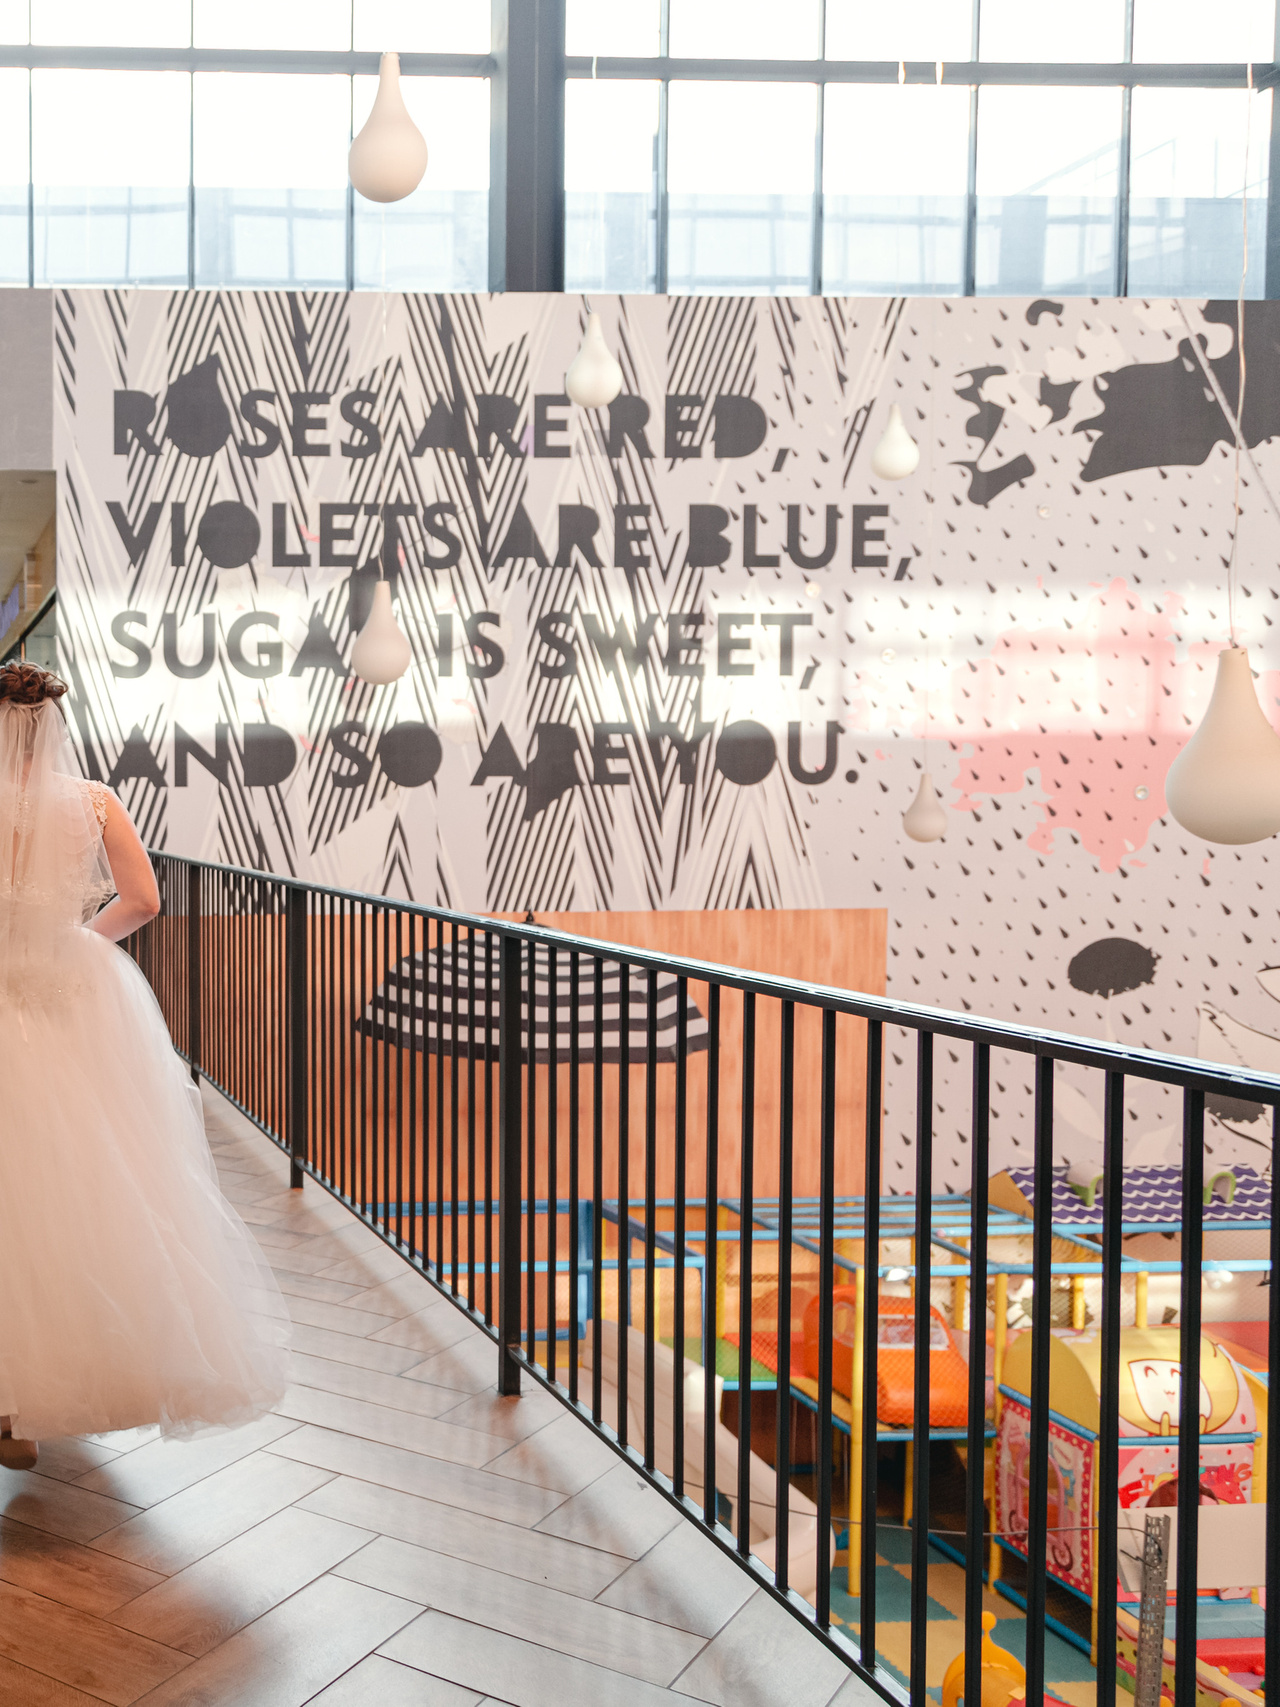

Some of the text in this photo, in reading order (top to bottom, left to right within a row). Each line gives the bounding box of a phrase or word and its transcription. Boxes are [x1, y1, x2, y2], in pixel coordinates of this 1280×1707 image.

[113, 386, 791, 473] ROSES ARE RED,
[105, 500, 912, 581] VIOLETS ARE BLUE,
[110, 610, 816, 691] SUGA IS SWEET,
[106, 719, 298, 788] AND
[330, 719, 443, 788] SO
[646, 719, 859, 786] YOU.
